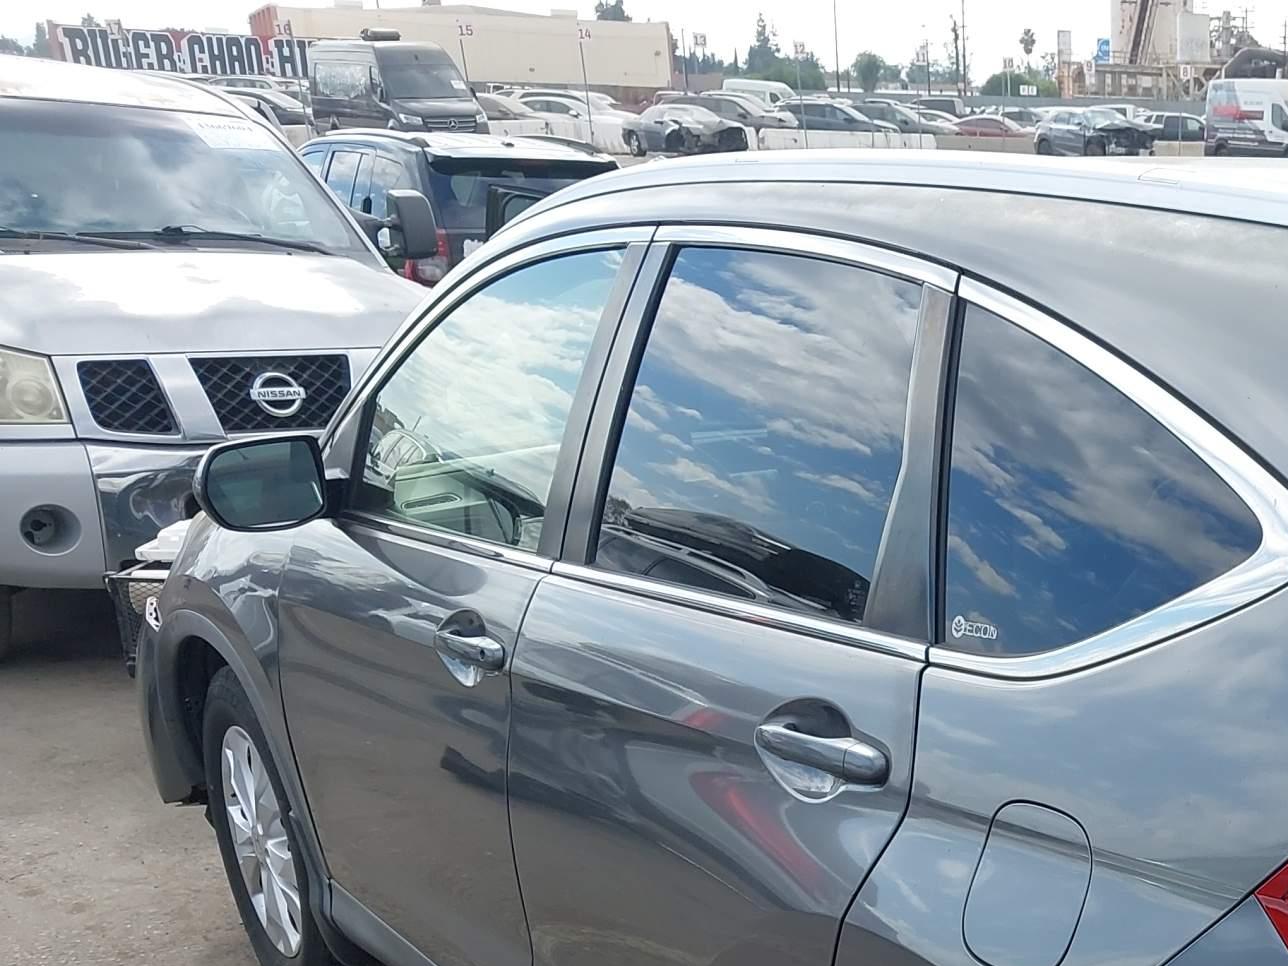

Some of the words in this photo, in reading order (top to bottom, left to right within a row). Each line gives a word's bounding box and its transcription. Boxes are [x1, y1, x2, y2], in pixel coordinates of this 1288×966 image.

[458, 24, 473, 36] 15
[579, 28, 591, 40] 14
[693, 34, 706, 46] 13
[794, 43, 805, 54] 12
[257, 390, 301, 398] NISSAN
